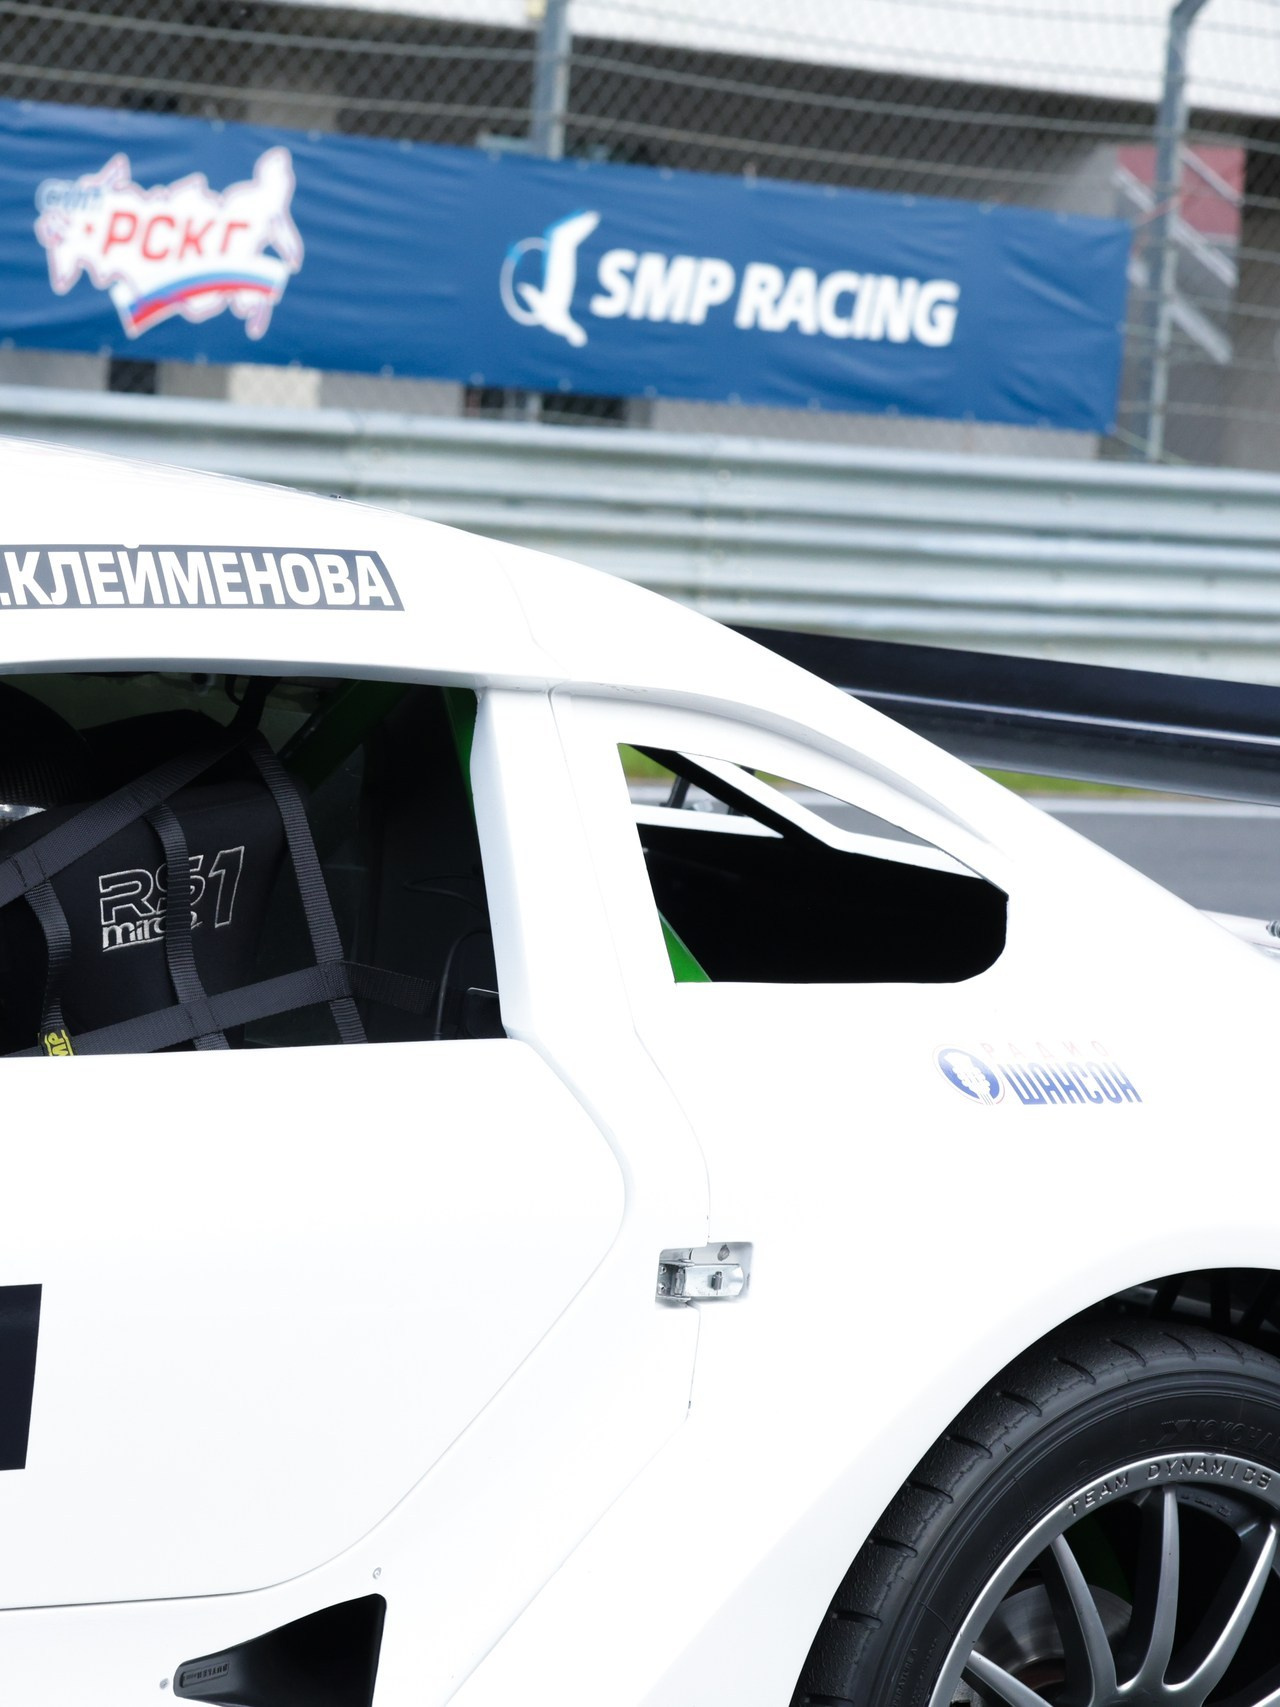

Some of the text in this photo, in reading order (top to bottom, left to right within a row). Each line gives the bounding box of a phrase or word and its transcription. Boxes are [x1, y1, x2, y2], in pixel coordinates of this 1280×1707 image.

[102, 210, 250, 262] РСКГ
[589, 248, 960, 347] SMP RACING
[47, 1032, 69, 1056] MP
[997, 1061, 1143, 1105] ШАНСОН
[1068, 1456, 1272, 1517] TEAM DYNAMICS
